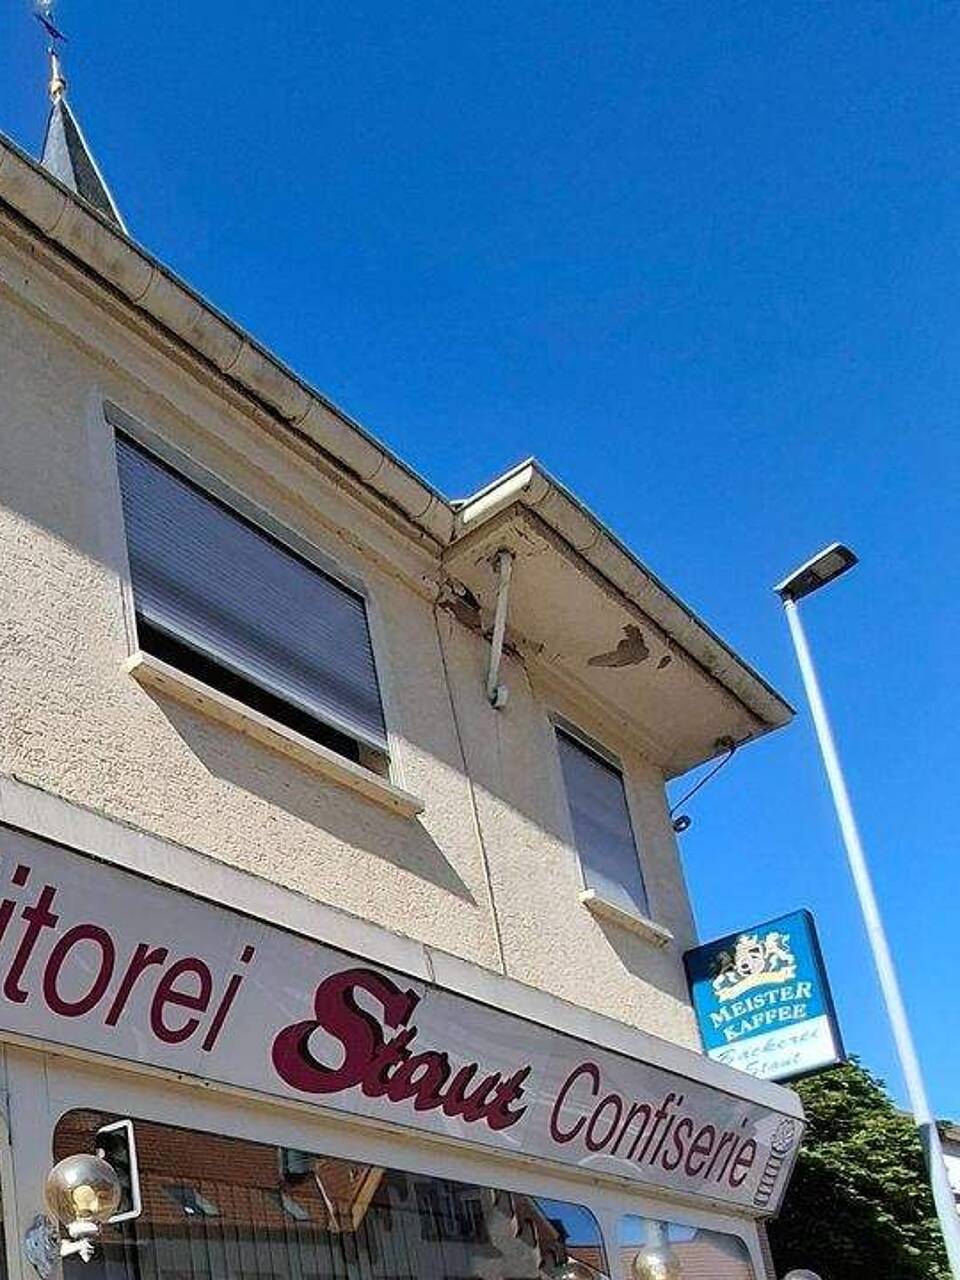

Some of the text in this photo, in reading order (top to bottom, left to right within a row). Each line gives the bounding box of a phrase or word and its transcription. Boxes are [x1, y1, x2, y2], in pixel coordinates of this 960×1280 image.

[708, 981, 813, 1029] MEISTER
[723, 1003, 808, 1042] KAFFEE
[272, 968, 532, 1131] Staut
[550, 1062, 758, 1188] Confiserie
